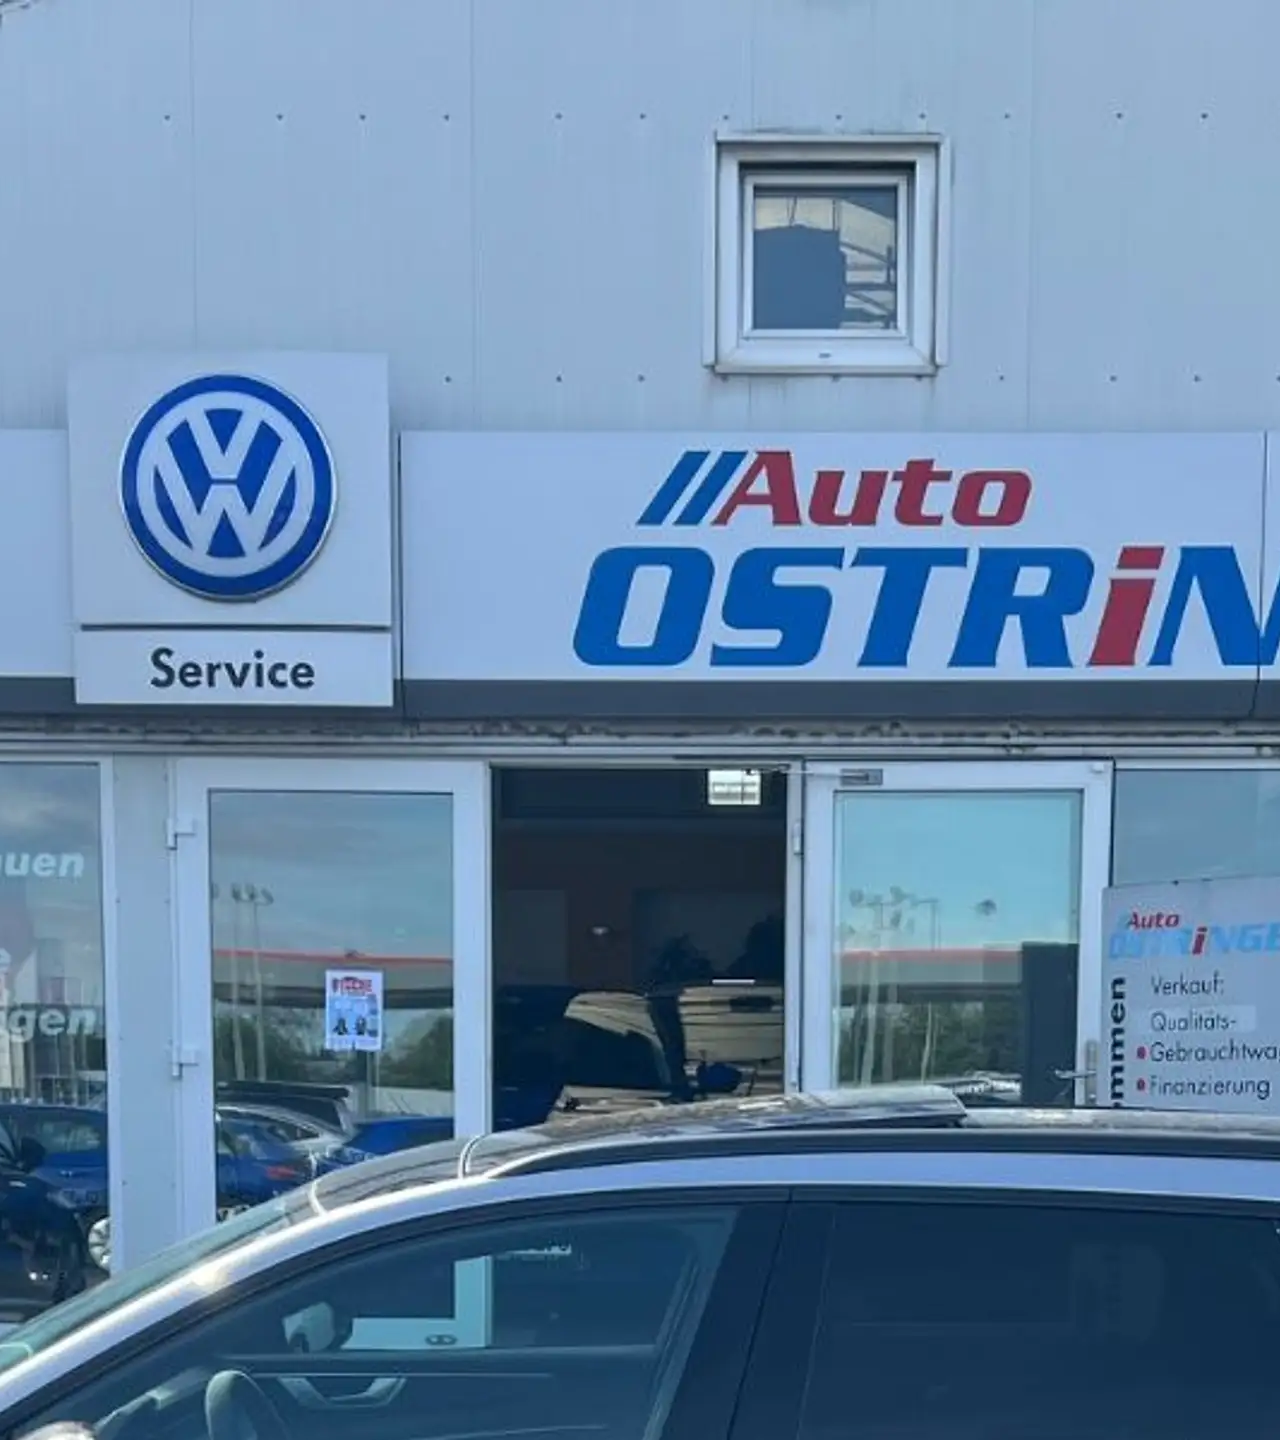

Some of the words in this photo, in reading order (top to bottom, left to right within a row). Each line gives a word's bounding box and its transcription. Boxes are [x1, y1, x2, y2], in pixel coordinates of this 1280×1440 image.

[150, 647, 315, 689] Service
[1126, 911, 1182, 931] Auto
[1150, 971, 1225, 997] Verkauf:
[1151, 1075, 1271, 1101] Finanzierung
